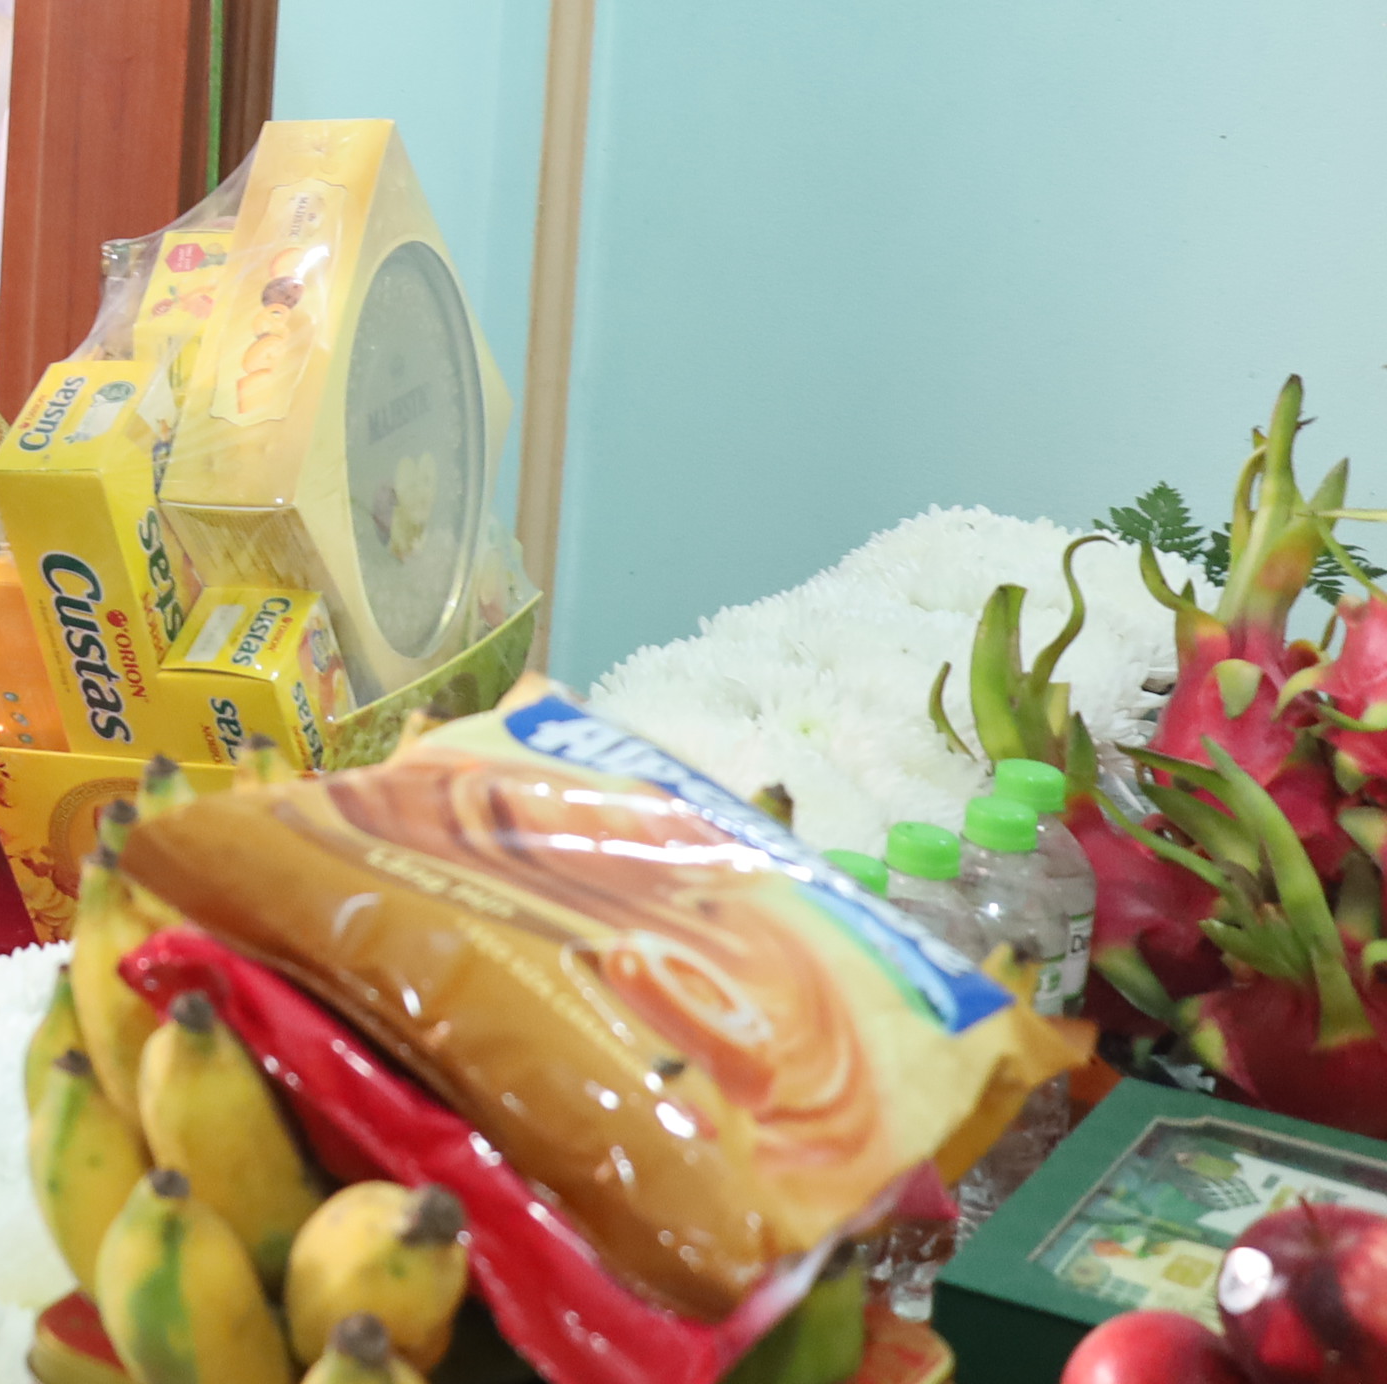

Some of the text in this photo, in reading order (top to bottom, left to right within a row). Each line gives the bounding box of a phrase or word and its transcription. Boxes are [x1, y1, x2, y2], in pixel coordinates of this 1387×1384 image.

[18, 375, 86, 452] Custas
[138, 508, 187, 643] stas
[40, 551, 132, 745] Custas
[114, 629, 148, 699] ORION
[231, 596, 292, 666] Custas
